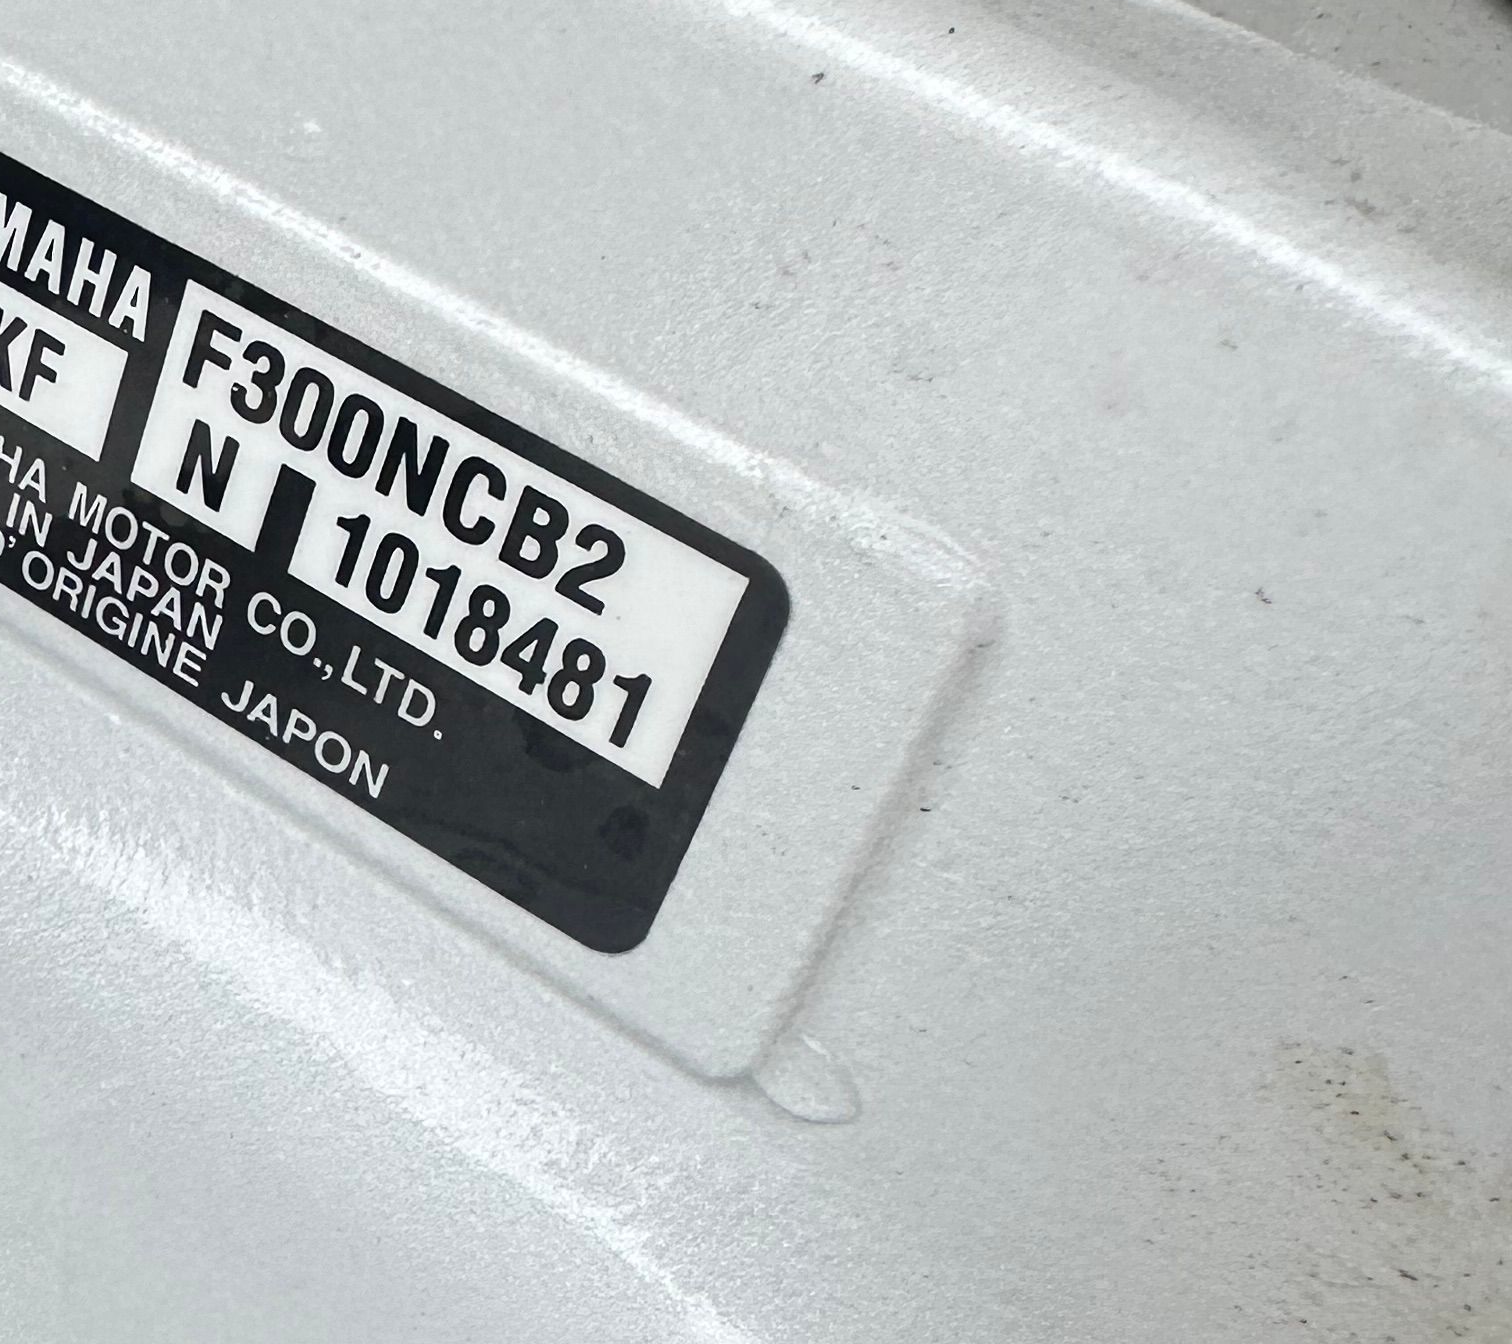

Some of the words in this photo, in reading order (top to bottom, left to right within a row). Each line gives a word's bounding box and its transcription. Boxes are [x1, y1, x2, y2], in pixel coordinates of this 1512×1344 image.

[182, 309, 626, 616] F300NCB2
[5, 492, 53, 548] IN
[66, 537, 223, 651] JAPAN
[68, 481, 231, 609] MOTOR
[175, 418, 240, 513] N
[334, 513, 652, 749] 1018481
[220, 680, 390, 799] JAPON
